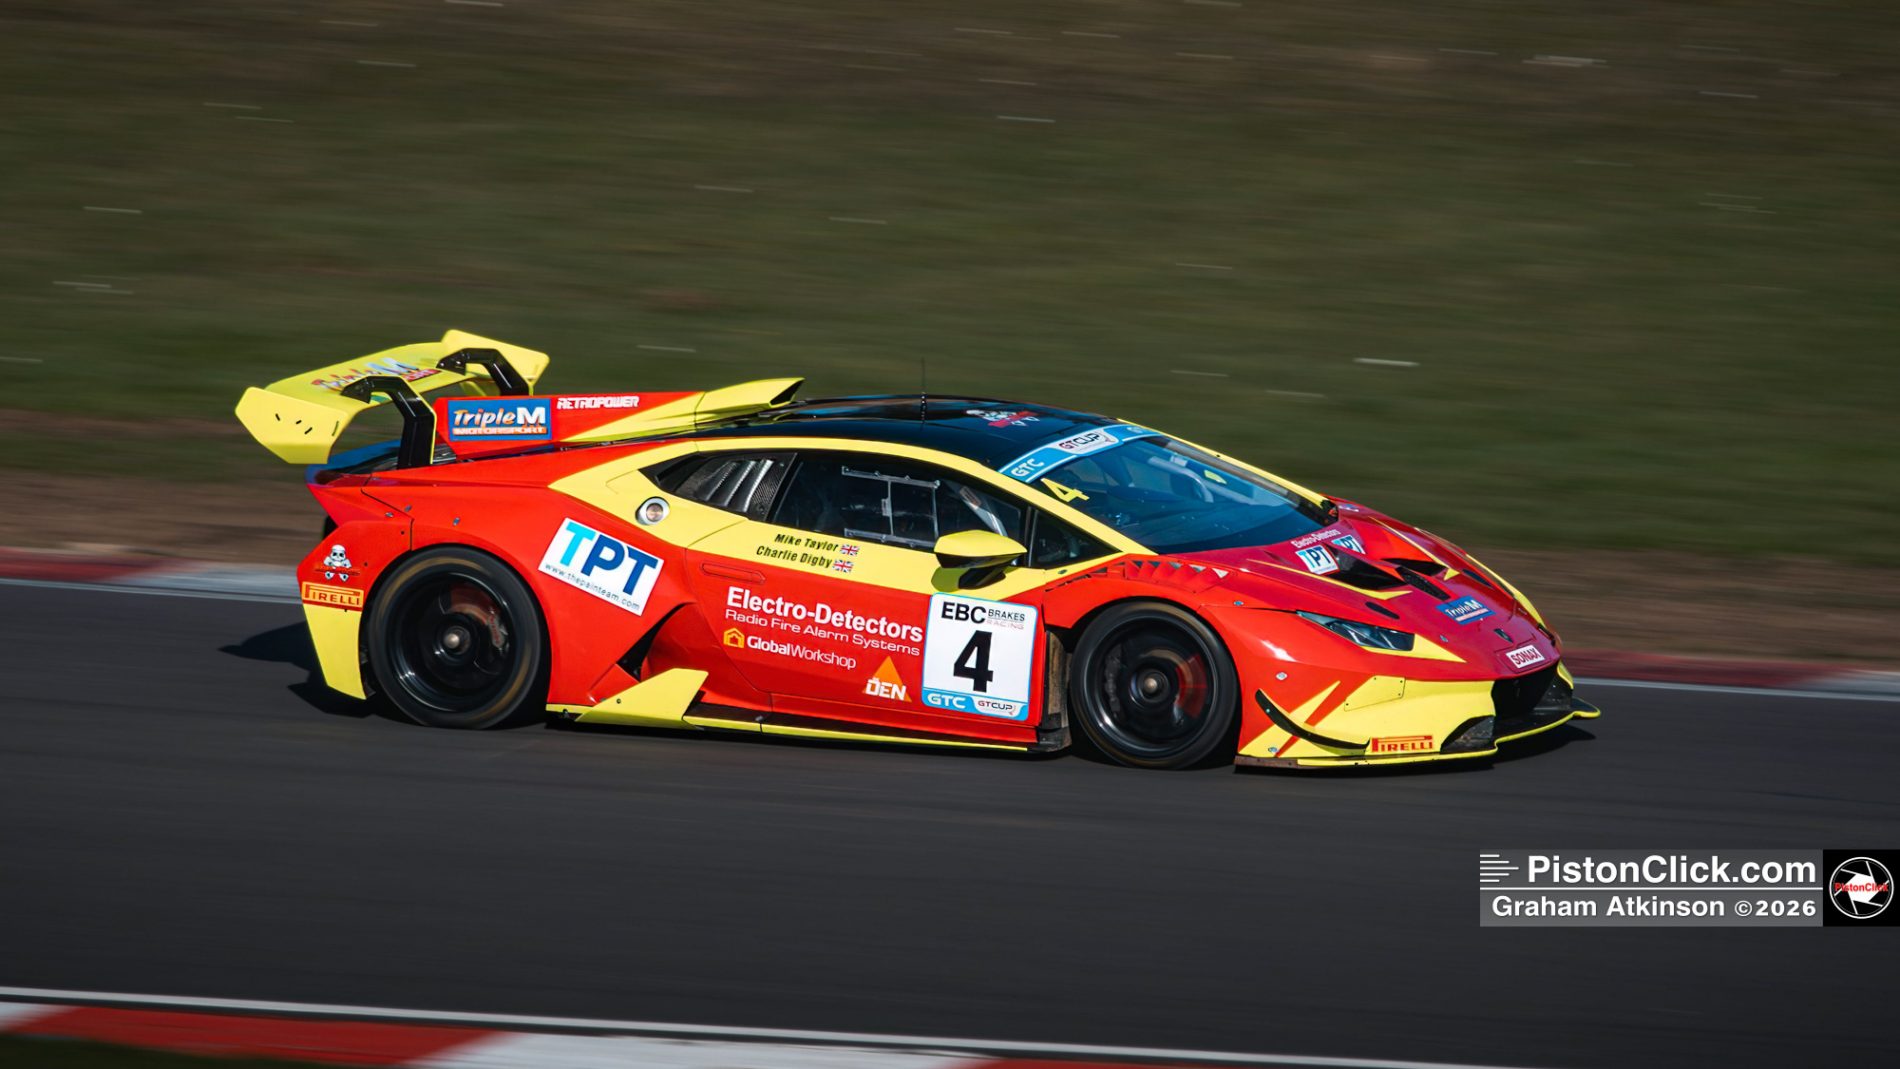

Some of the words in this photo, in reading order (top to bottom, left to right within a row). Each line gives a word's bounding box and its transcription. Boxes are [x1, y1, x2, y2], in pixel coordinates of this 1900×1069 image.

[557, 396, 639, 409] RETROPOWER
[1011, 458, 1045, 477] GTC
[1041, 478, 1090, 502] 4
[774, 534, 802, 545] Mike
[804, 538, 839, 552] Taylor
[560, 521, 659, 596] TPT
[756, 546, 798, 561] Charlie
[800, 553, 832, 568] Digby
[1298, 546, 1331, 568] TPT
[304, 584, 361, 606] PIRELLI
[727, 586, 923, 642] Electro-Detectors
[941, 601, 987, 624] EBC
[988, 608, 1025, 622] BRAKES
[725, 609, 768, 627] Radio
[771, 618, 801, 633] Fire
[803, 625, 849, 643] Alarm
[852, 634, 920, 656] Systems
[987, 619, 1025, 630] RACING
[953, 630, 994, 693] 4
[1510, 648, 1541, 665] SONAX
[927, 693, 966, 709] GTC
[1372, 736, 1433, 752] PIRELLI
